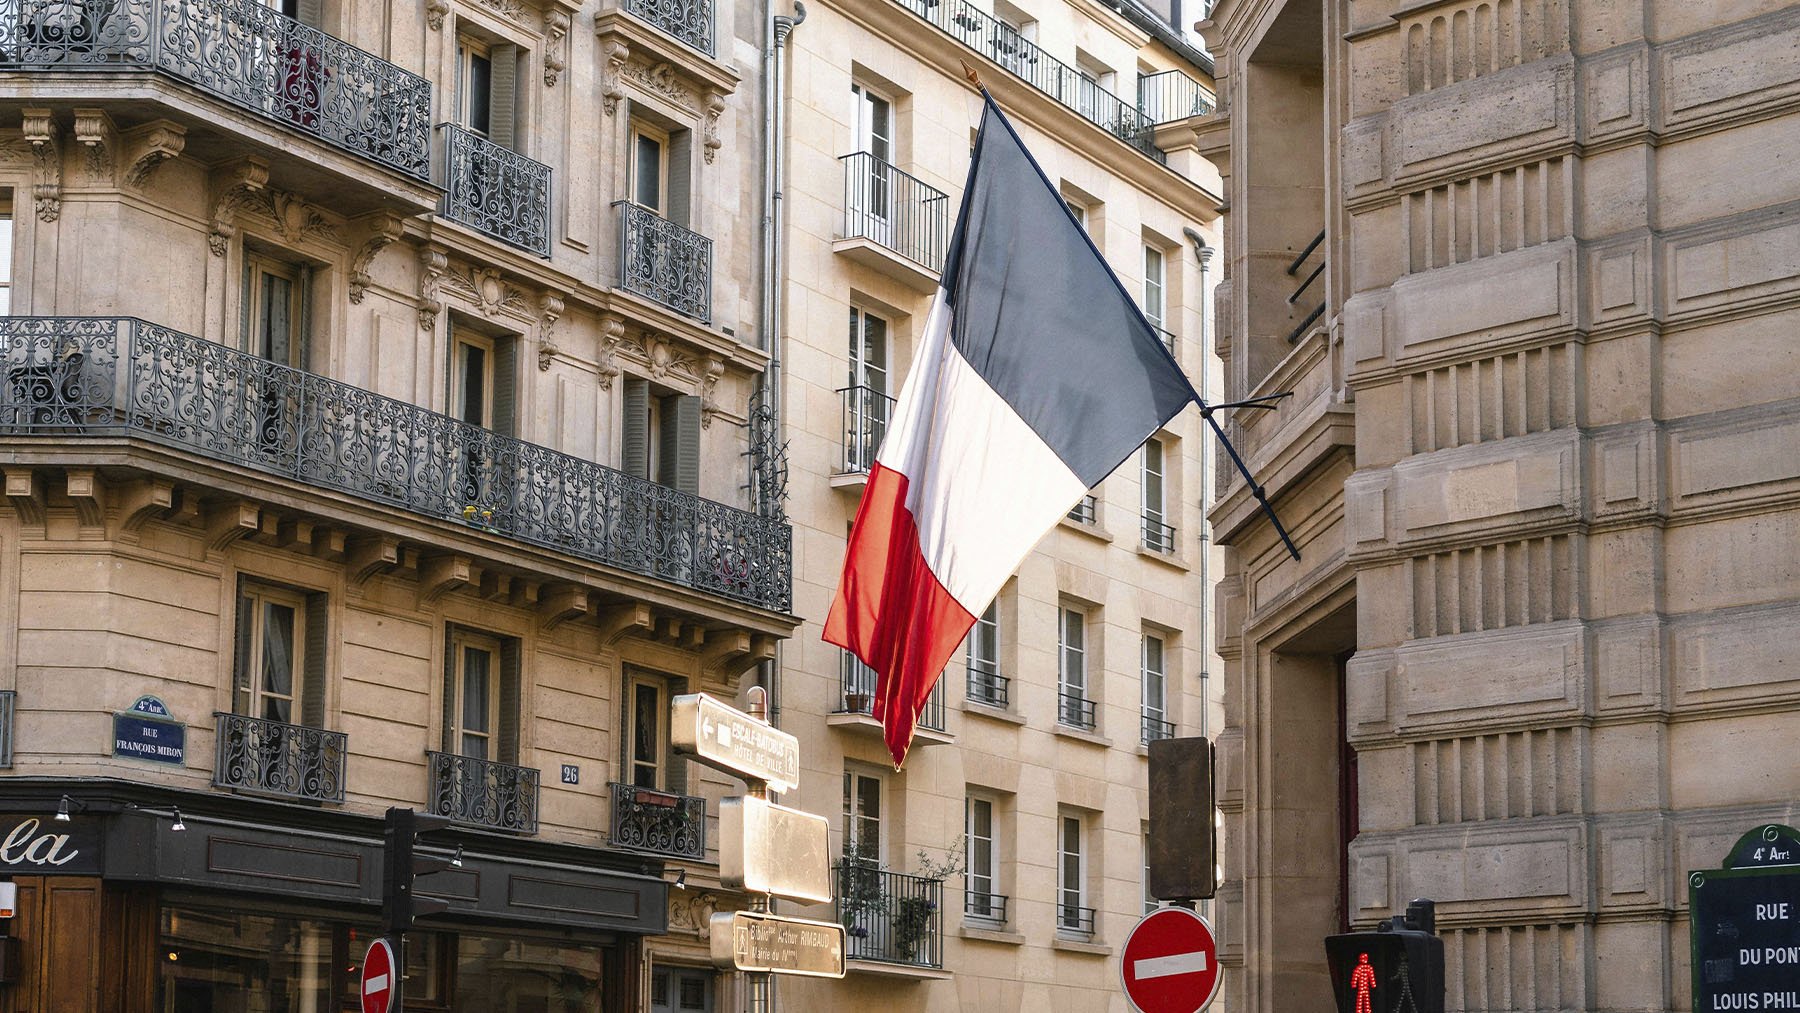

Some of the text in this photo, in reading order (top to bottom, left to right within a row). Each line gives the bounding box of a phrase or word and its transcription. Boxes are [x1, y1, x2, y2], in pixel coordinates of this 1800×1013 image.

[143, 727, 158, 738] RUE
[116, 740, 183, 758] FRANÇOIS MIRON
[756, 752, 765, 767] DE
[767, 758, 783, 773] VILLE
[564, 767, 576, 782] 26
[1756, 903, 1789, 920] RUE
[777, 929, 798, 945] Arthur
[800, 930, 830, 948] RIMBAUD
[771, 949, 780, 961] du
[1739, 947, 1800, 965] DU PON
[1713, 991, 1800, 1010] LOUIS PHIL
